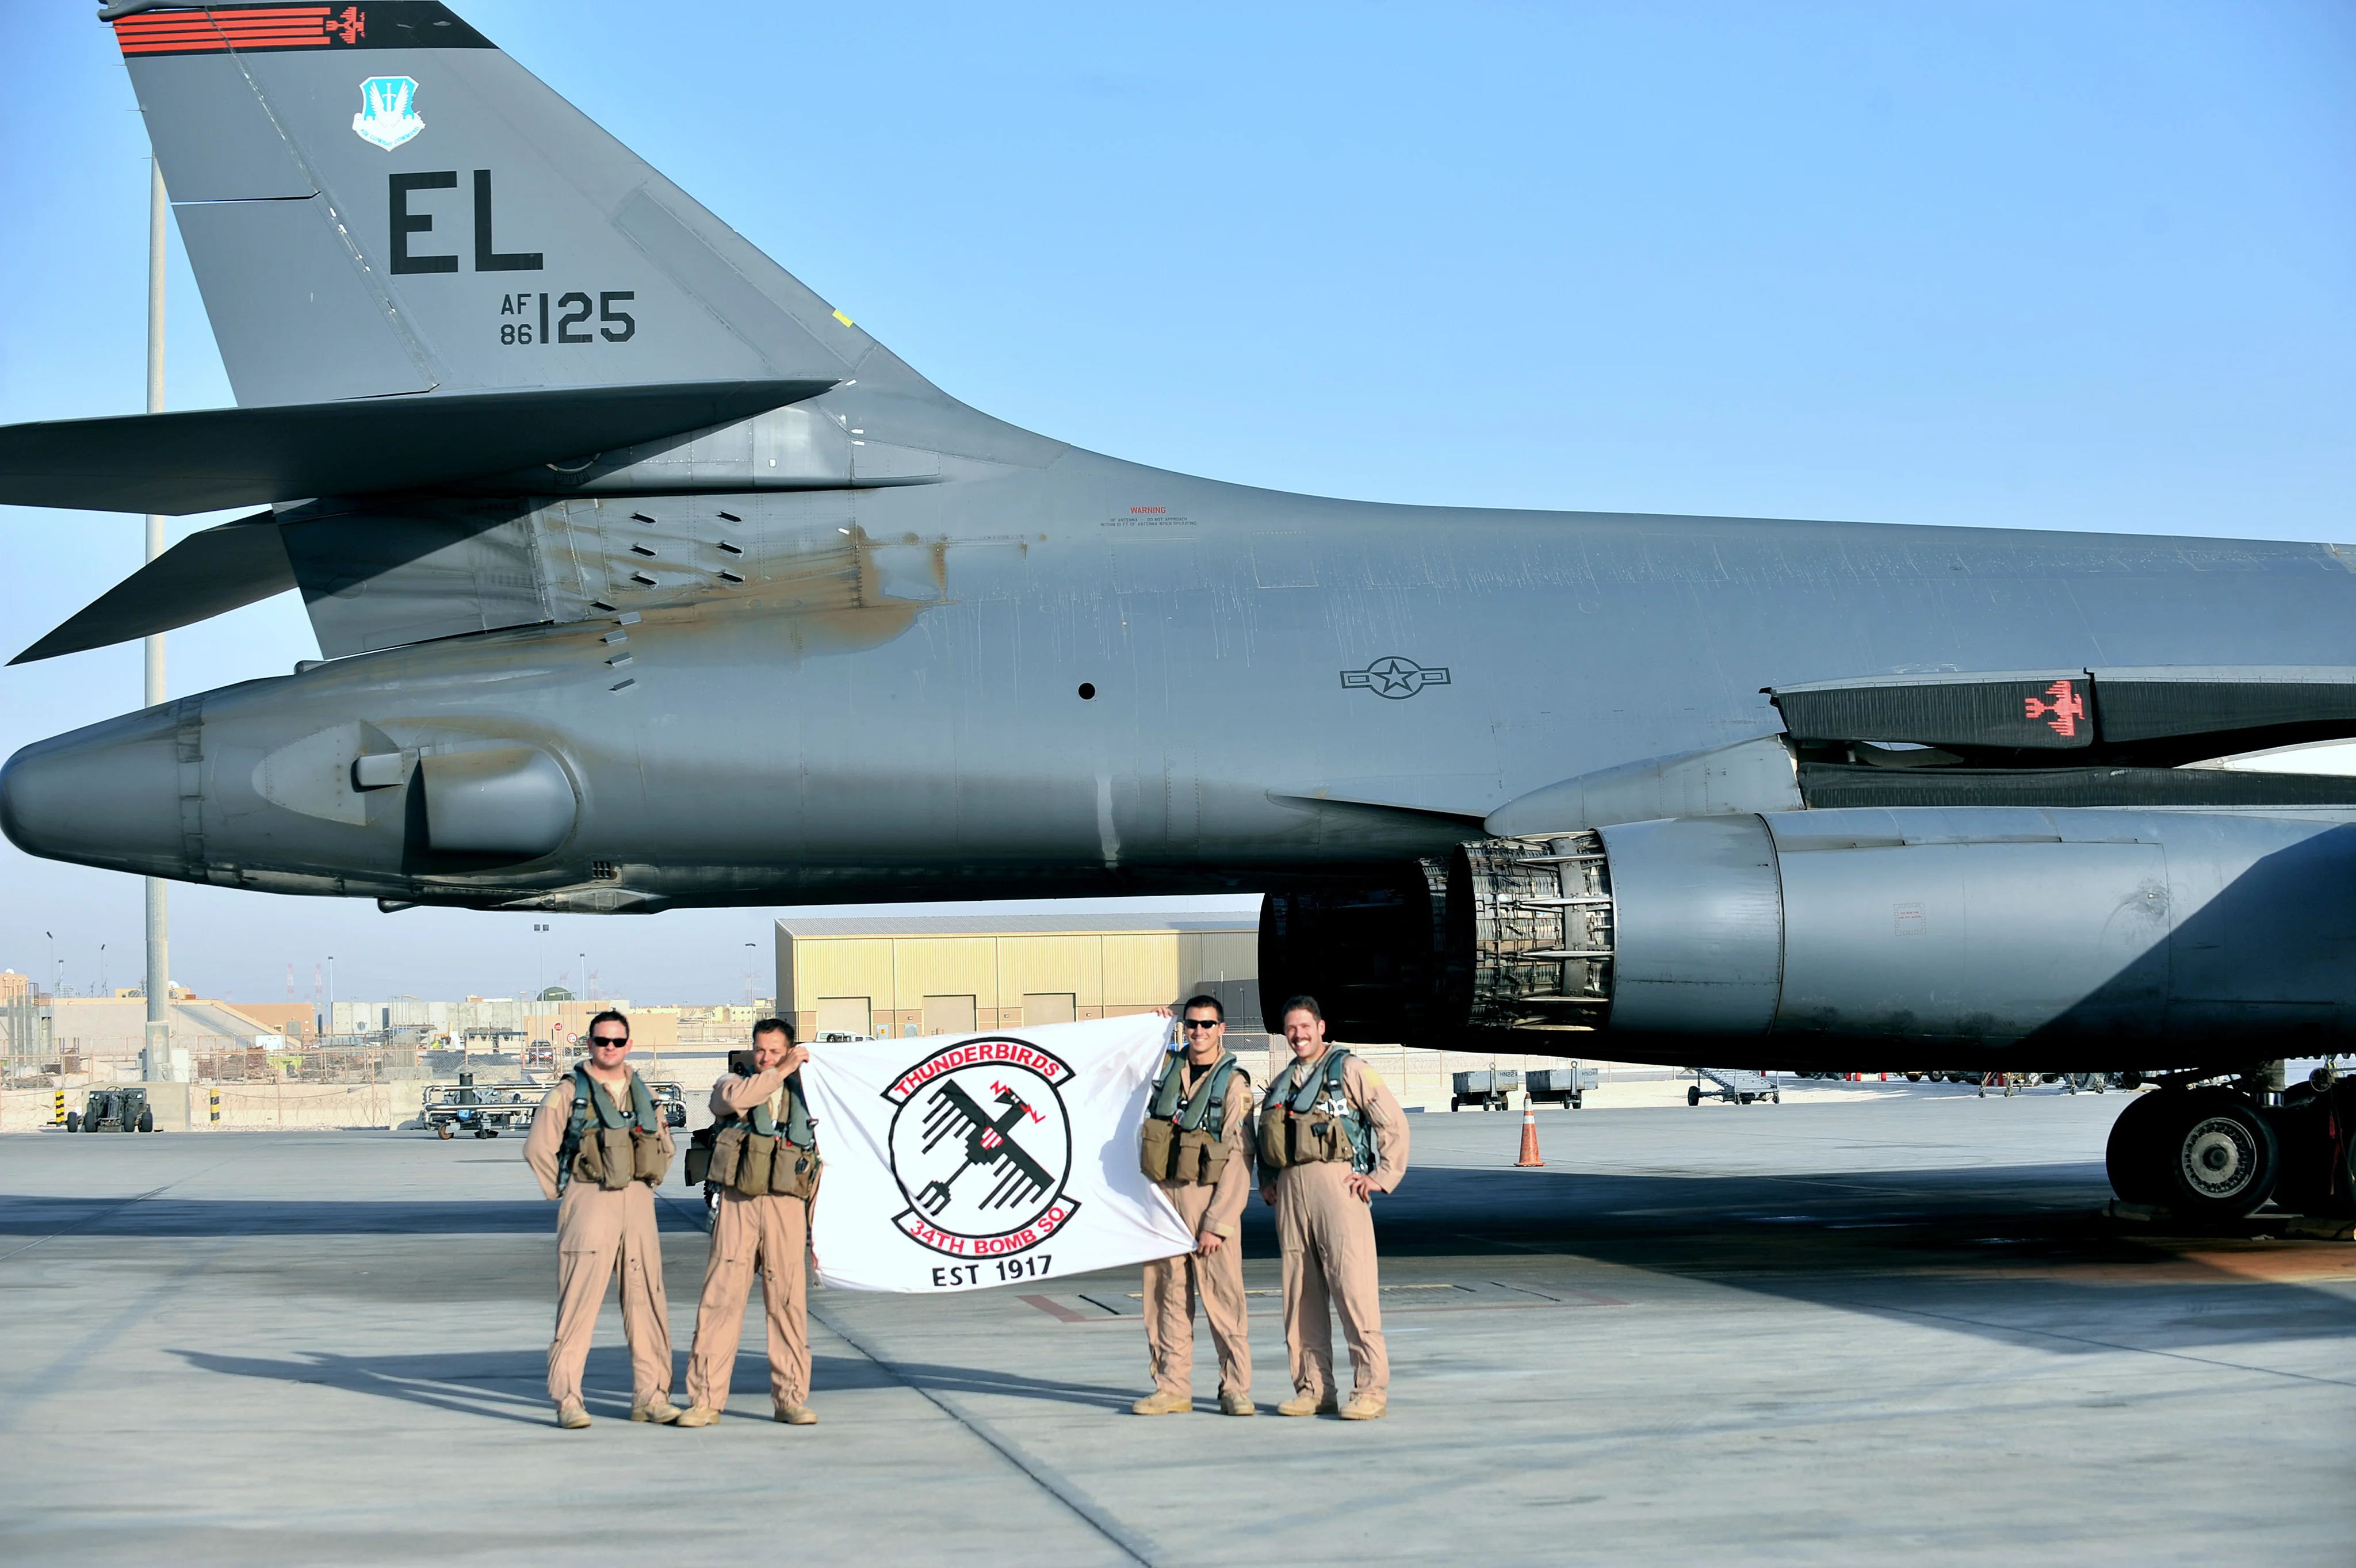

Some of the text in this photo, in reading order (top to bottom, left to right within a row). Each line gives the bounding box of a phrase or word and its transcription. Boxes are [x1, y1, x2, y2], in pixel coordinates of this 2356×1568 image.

[388, 169, 544, 275] EL
[500, 293, 531, 315] AF
[500, 291, 635, 345] 86 125
[894, 1043, 1060, 1096] THUNDERBIRDS
[910, 1220, 965, 1255] 34TH
[974, 1229, 1037, 1254] BOMB
[932, 1255, 1051, 1286] EST 1917
